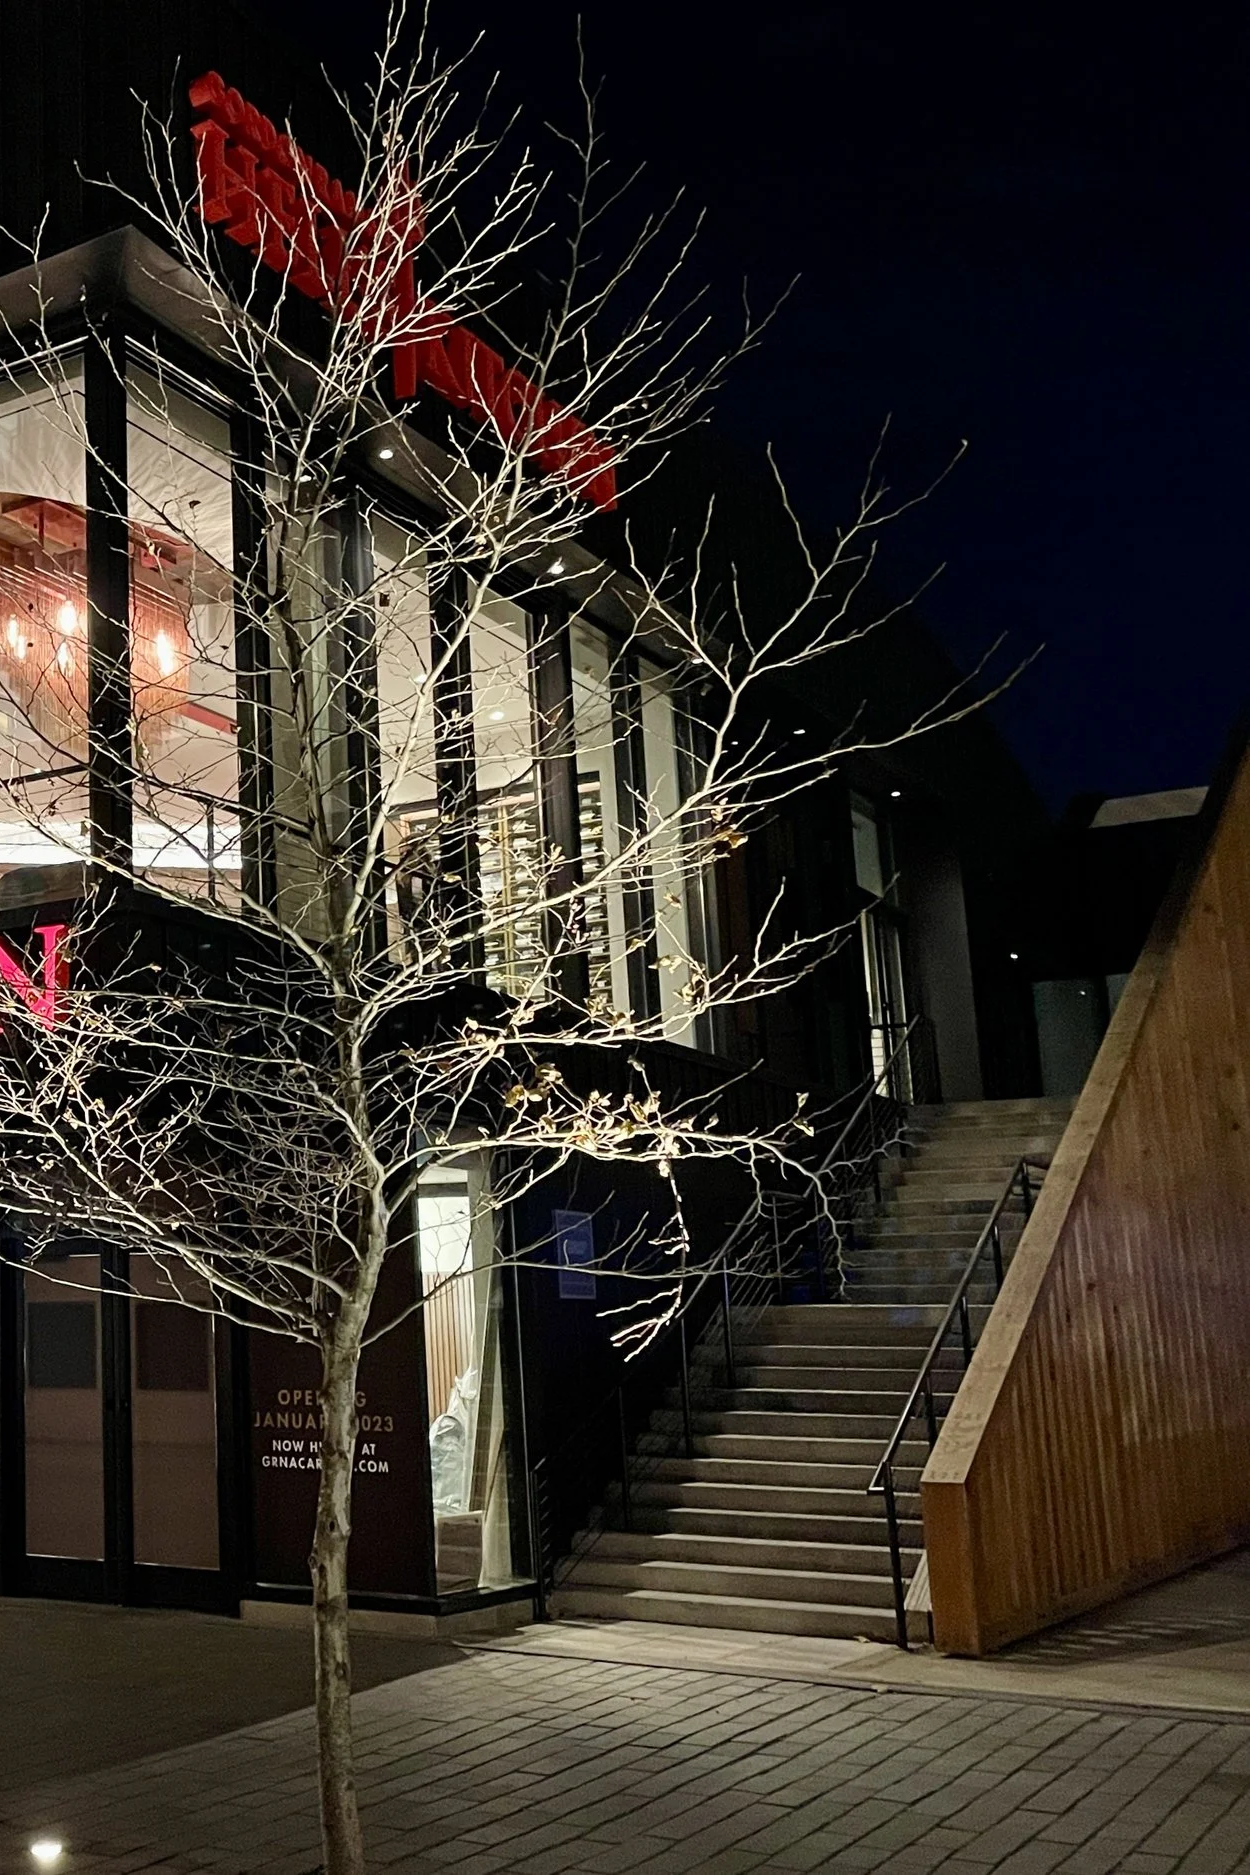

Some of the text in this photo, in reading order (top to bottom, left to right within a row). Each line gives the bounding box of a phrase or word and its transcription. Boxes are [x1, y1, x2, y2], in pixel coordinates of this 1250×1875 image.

[278, 1389, 367, 1407] OPEG
[254, 1411, 394, 1432] JANUA 023
[272, 1439, 304, 1452] NOW
[361, 1443, 376, 1456] AT
[261, 1455, 389, 1473] GRNACAR.COM
